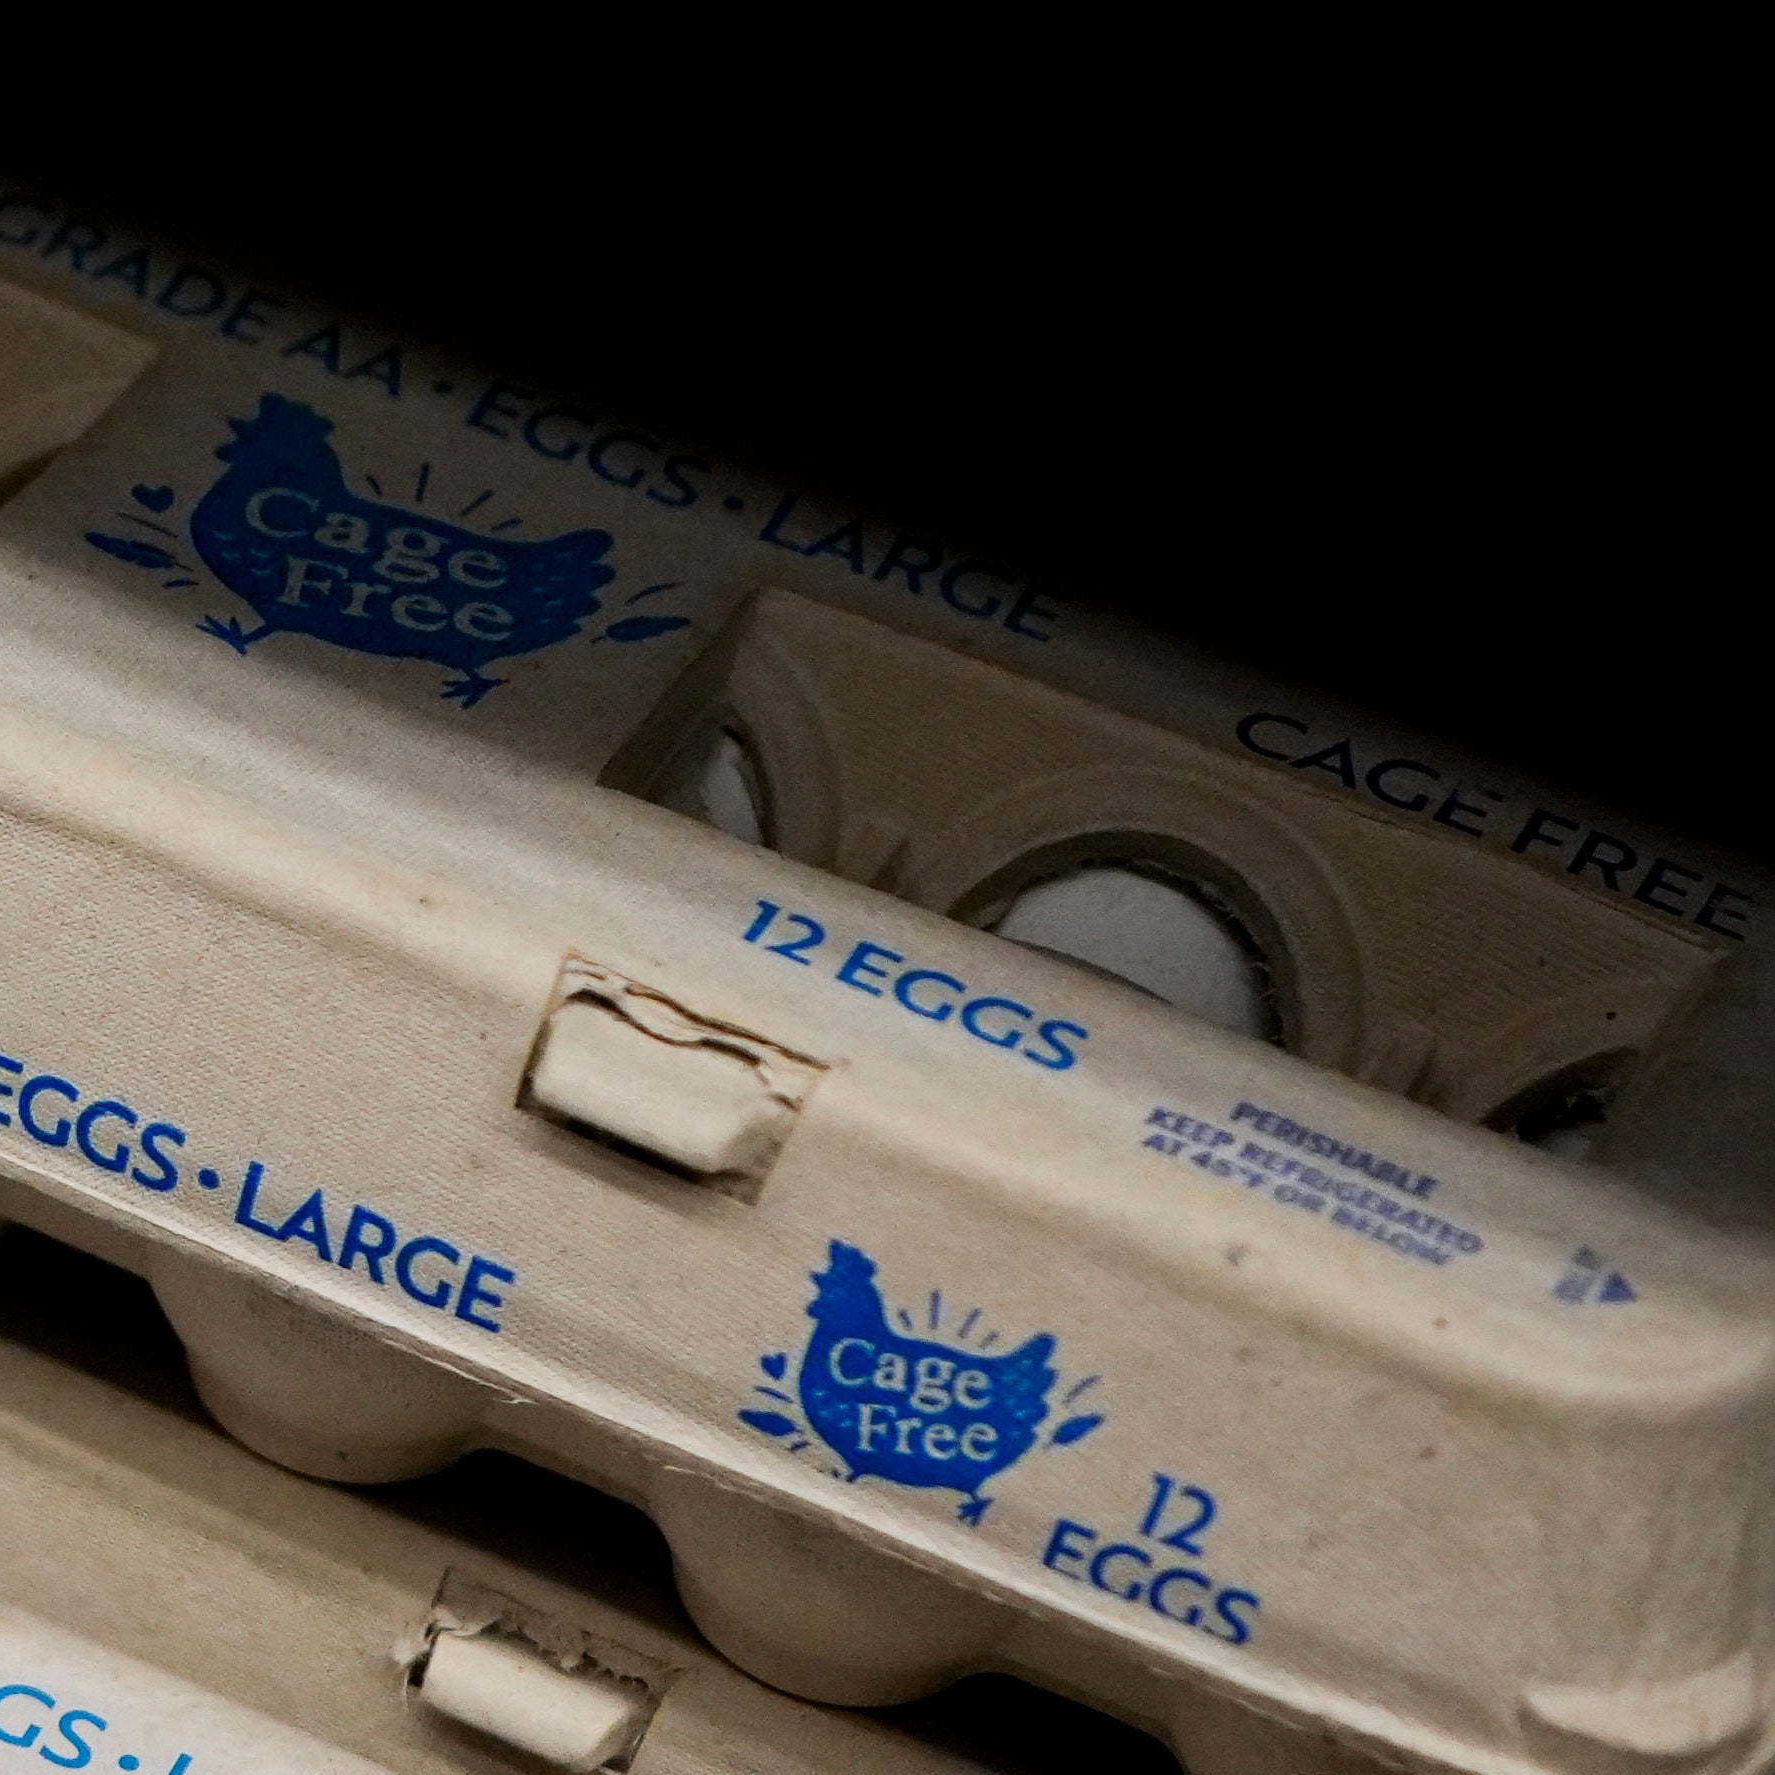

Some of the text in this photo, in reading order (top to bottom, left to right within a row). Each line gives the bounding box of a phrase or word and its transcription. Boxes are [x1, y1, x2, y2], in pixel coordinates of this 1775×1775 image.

[246, 485, 508, 589] Cage
[281, 322, 407, 397] AA
[467, 377, 714, 511] EGGS
[757, 490, 1062, 644] LARGE
[276, 552, 517, 642] Free
[1235, 712, 1760, 942] CAGE FREE
[740, 898, 1090, 1078] 12 EGGS
[233, 1159, 516, 1335] LARGE
[828, 1336, 995, 1411] Cage
[854, 1402, 999, 1464] Free
[1139, 1472, 1218, 1557] 12
[1040, 1517, 1260, 1646] EGGS
